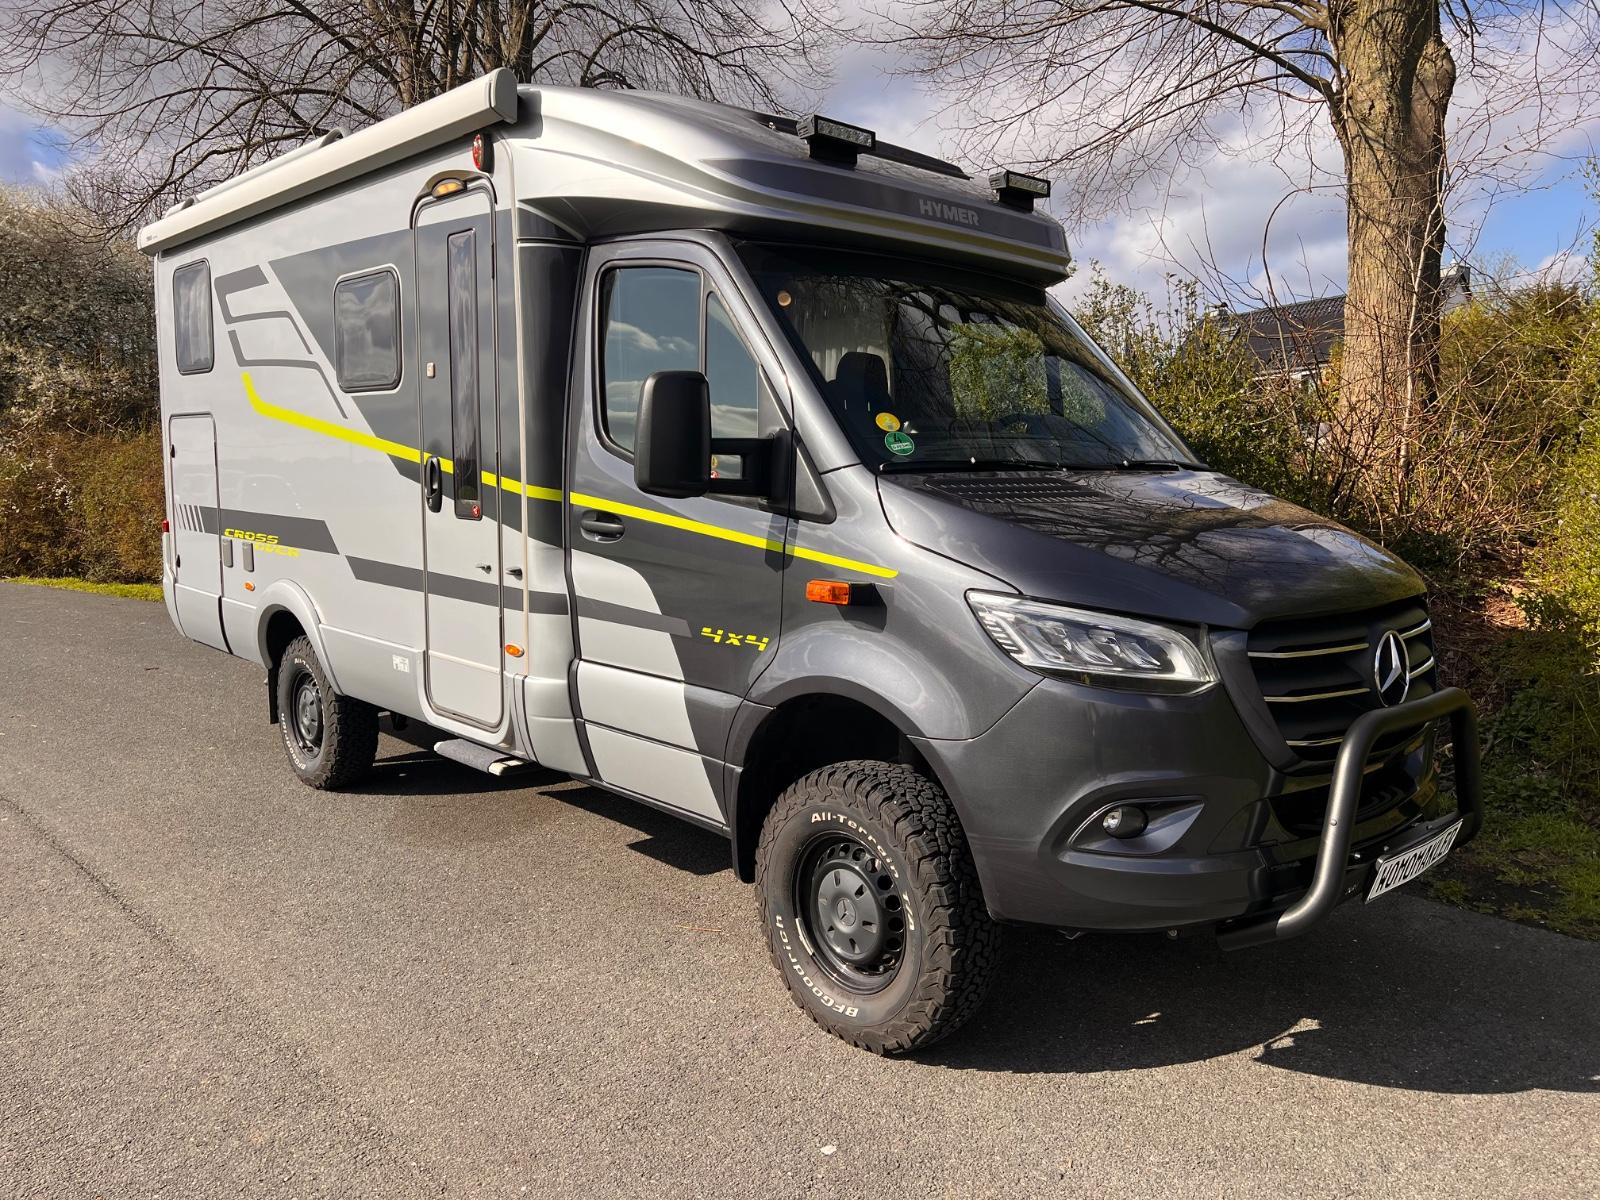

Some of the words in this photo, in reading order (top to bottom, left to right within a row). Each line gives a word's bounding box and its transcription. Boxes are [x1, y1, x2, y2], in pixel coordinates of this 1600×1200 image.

[919, 199, 980, 226] HYMER
[224, 528, 279, 545] CROSS
[701, 627, 769, 652] 4x4
[811, 811, 899, 879] All-Terrain
[775, 914, 860, 1018] BFGoodrich
